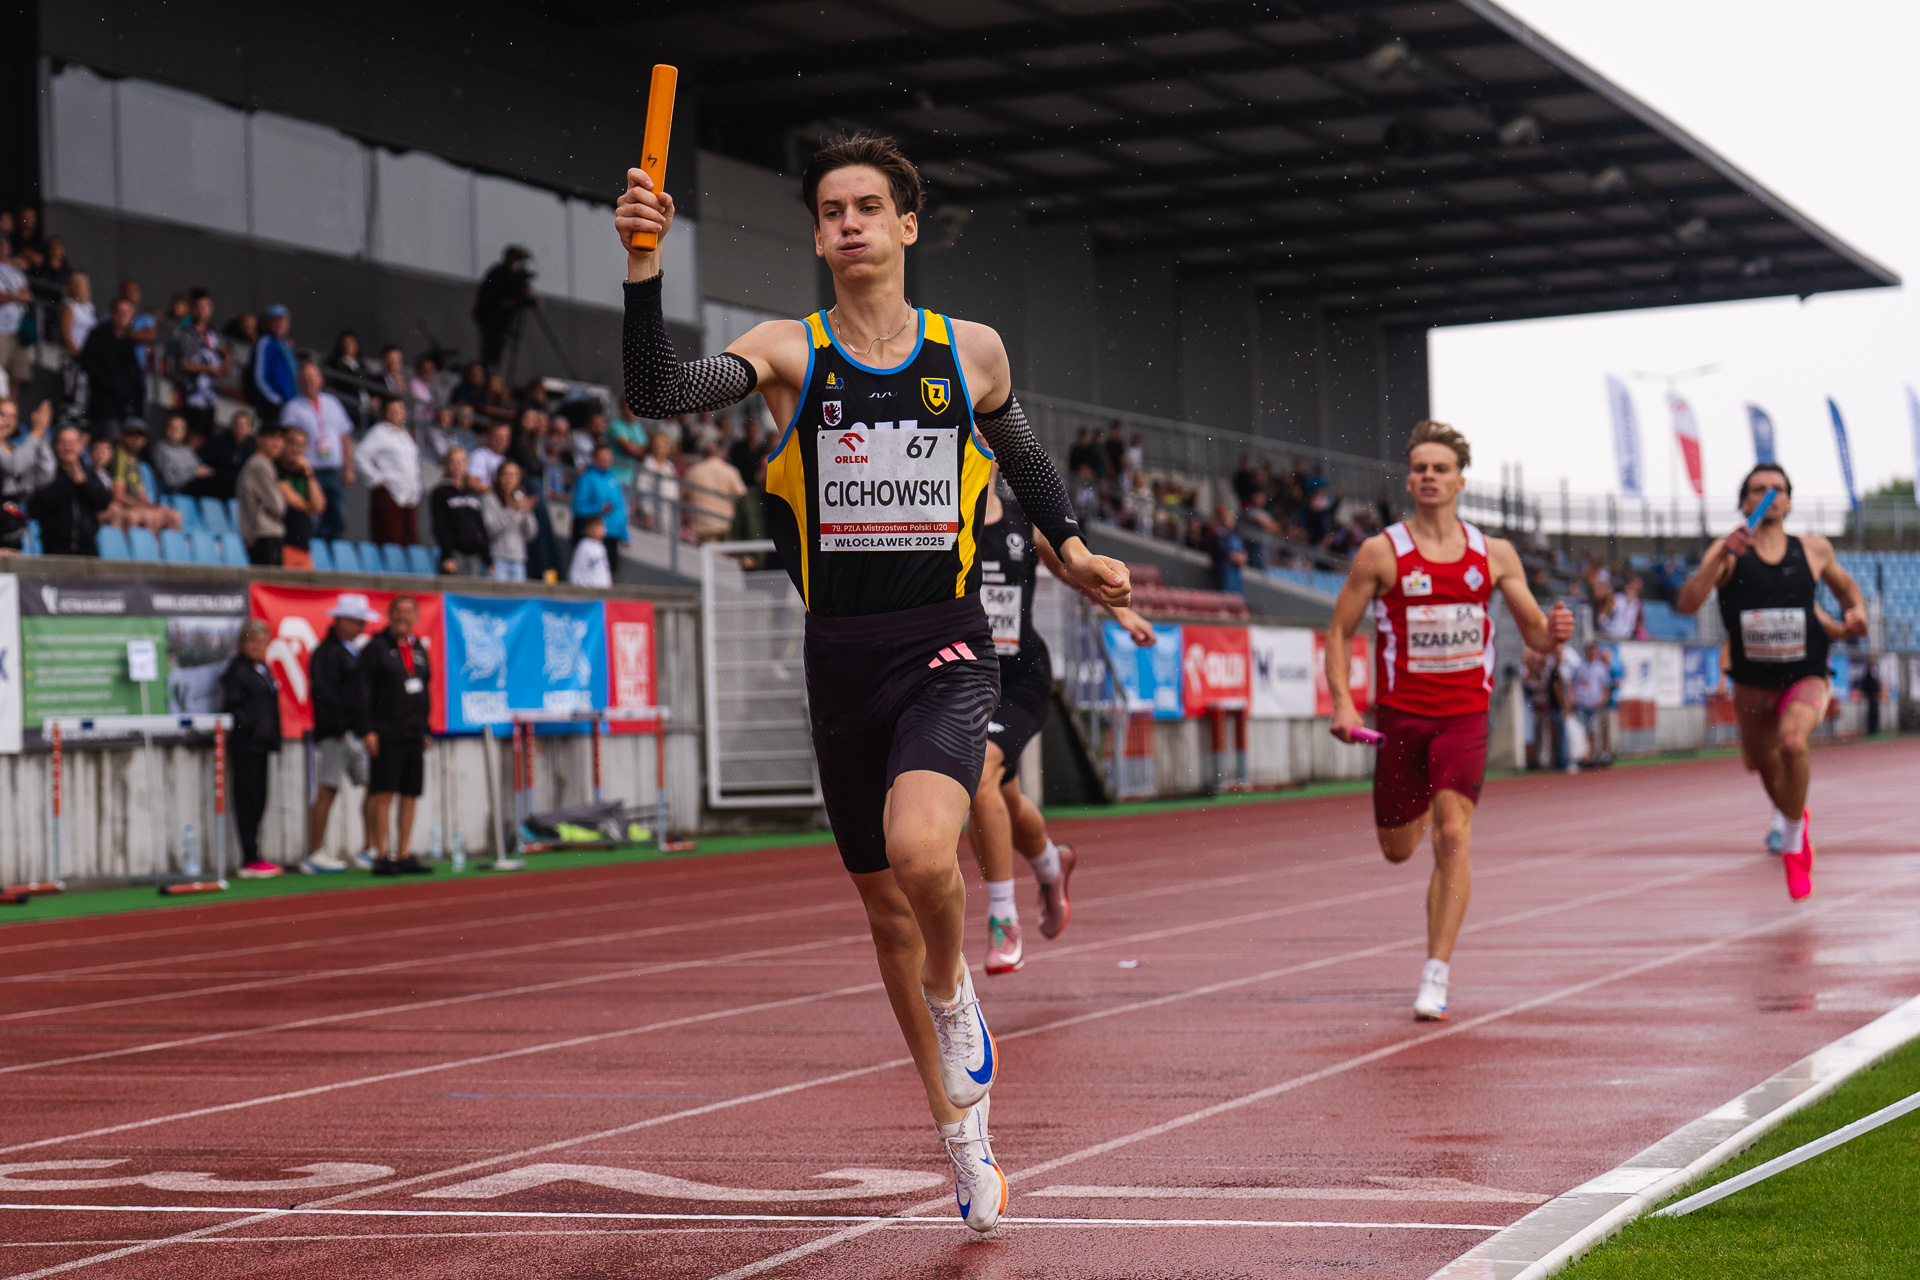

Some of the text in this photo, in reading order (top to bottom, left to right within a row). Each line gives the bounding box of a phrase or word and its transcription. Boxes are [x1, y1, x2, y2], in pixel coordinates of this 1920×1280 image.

[932, 388, 941, 399] Z
[906, 435, 938, 459] 67
[835, 455, 869, 464] ORLEN
[824, 480, 951, 507] CICHOWSKI
[862, 524, 908, 532] Mistrzostwa
[834, 537, 945, 547] WŁOCŁAWEK 2025
[990, 614, 1016, 629] ZYK
